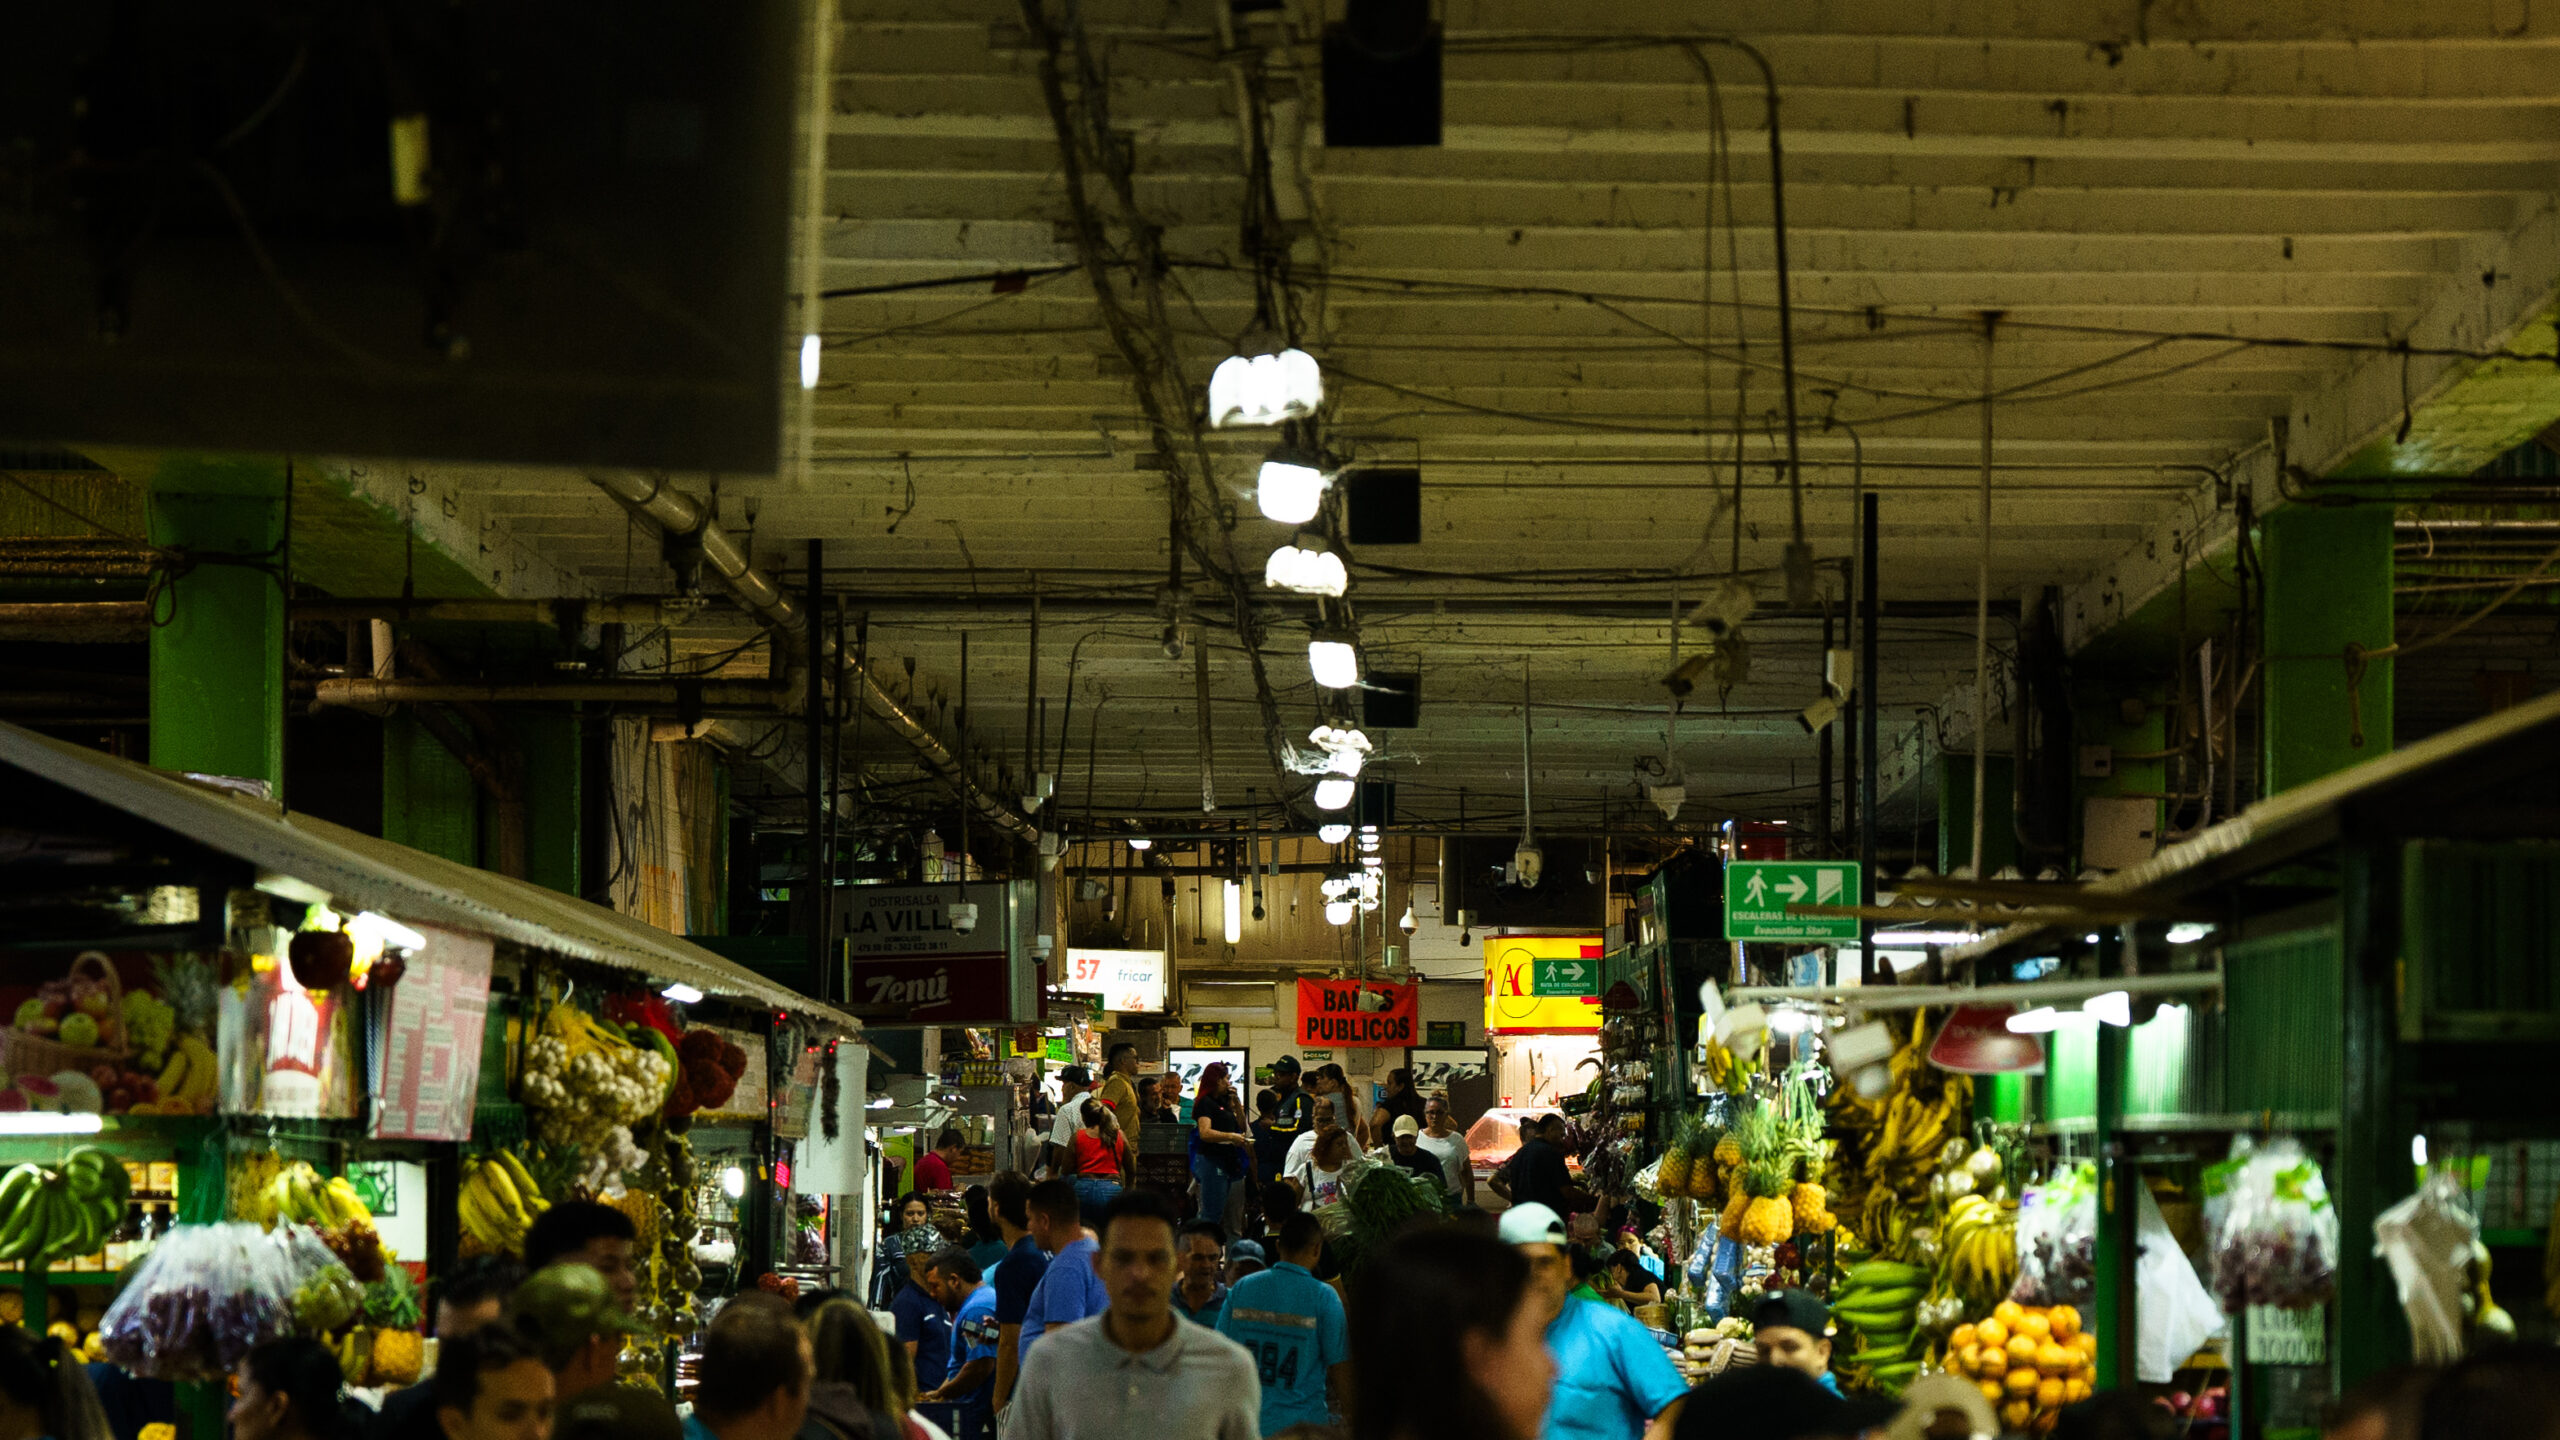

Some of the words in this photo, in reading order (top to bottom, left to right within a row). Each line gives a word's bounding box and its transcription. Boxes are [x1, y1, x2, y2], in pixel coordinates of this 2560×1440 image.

[869, 895, 940, 907] DISTRISALSA
[844, 911, 877, 933] LA
[885, 910, 952, 932] VILL
[1732, 911, 1783, 921] ESCALERAS
[1754, 925, 1803, 936] Evacuation
[1076, 958, 1101, 980] 57
[1118, 969, 1152, 982] fricar
[865, 968, 951, 1003] Zenú
[1307, 1017, 1410, 1041] PUBLICOS
